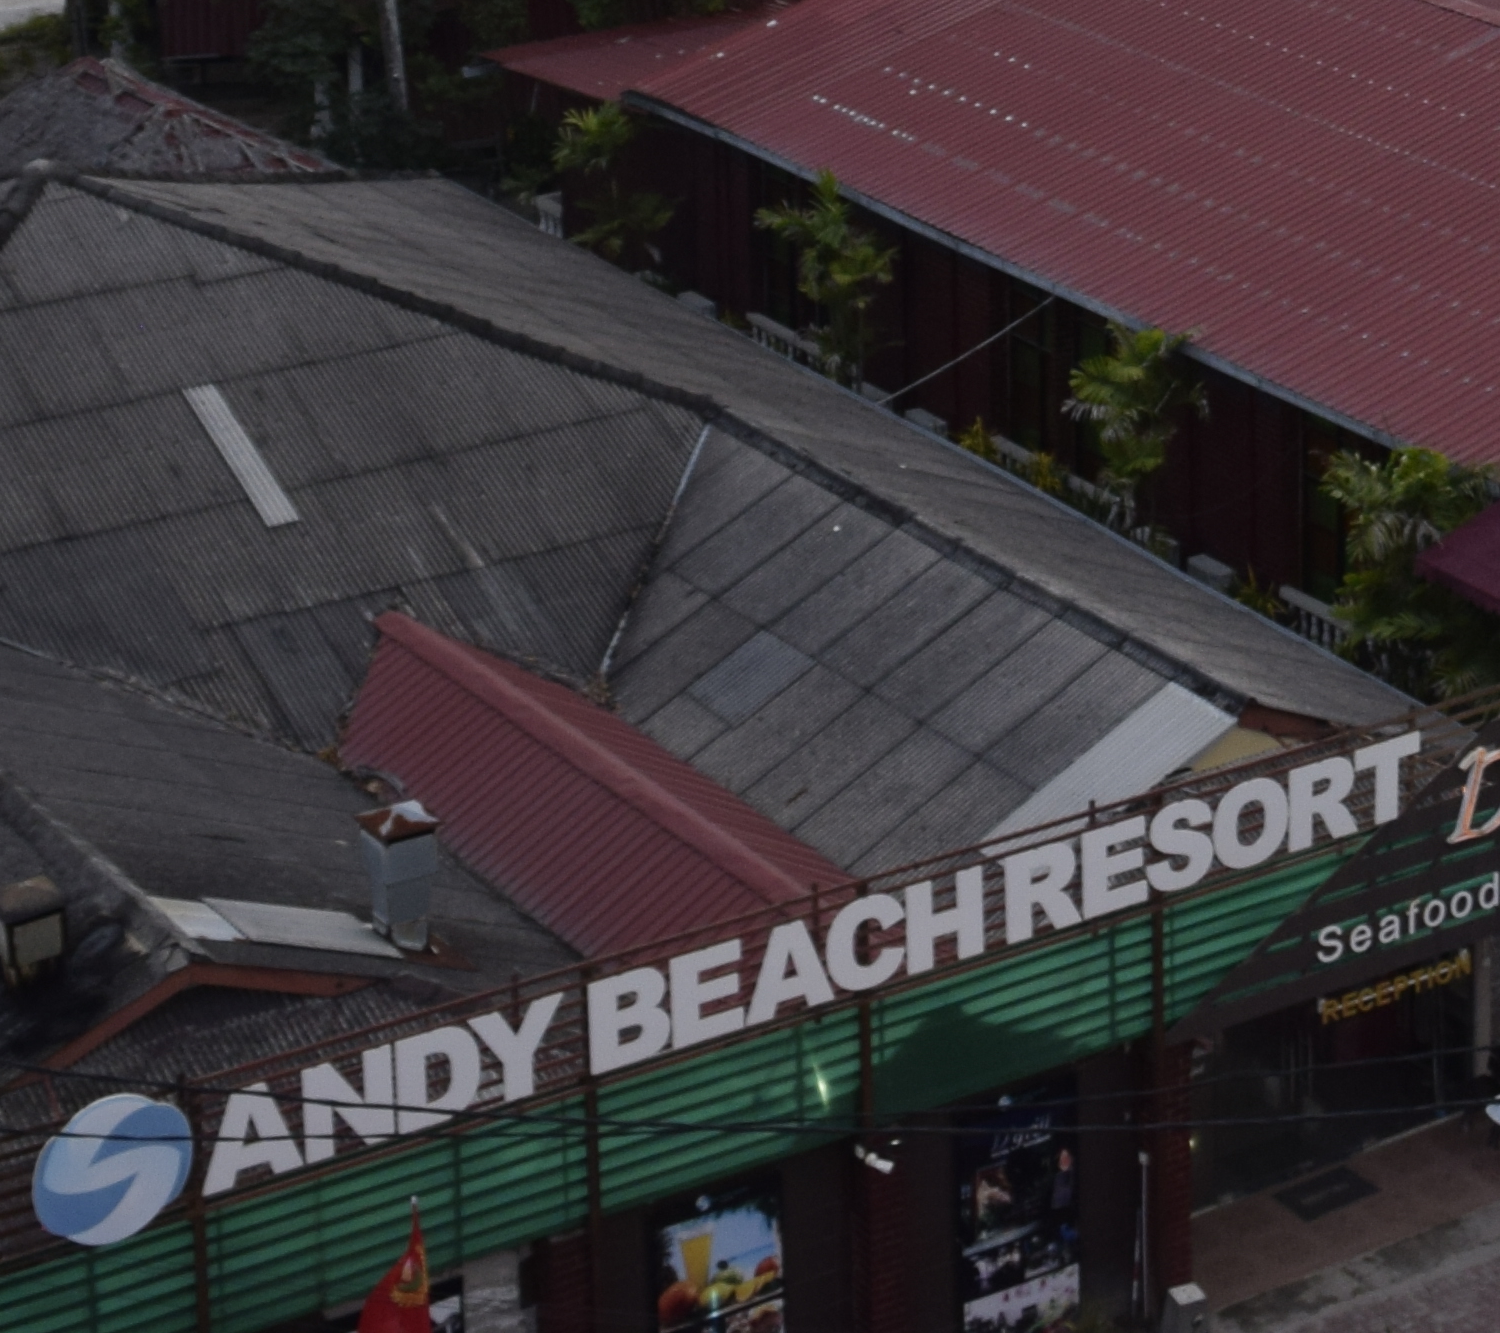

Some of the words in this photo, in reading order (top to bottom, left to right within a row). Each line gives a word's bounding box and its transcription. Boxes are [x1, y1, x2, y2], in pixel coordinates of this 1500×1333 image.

[586, 864, 986, 1076] BEACH
[999, 730, 1422, 945] RESORT
[1320, 953, 1473, 1026] RECEPTION
